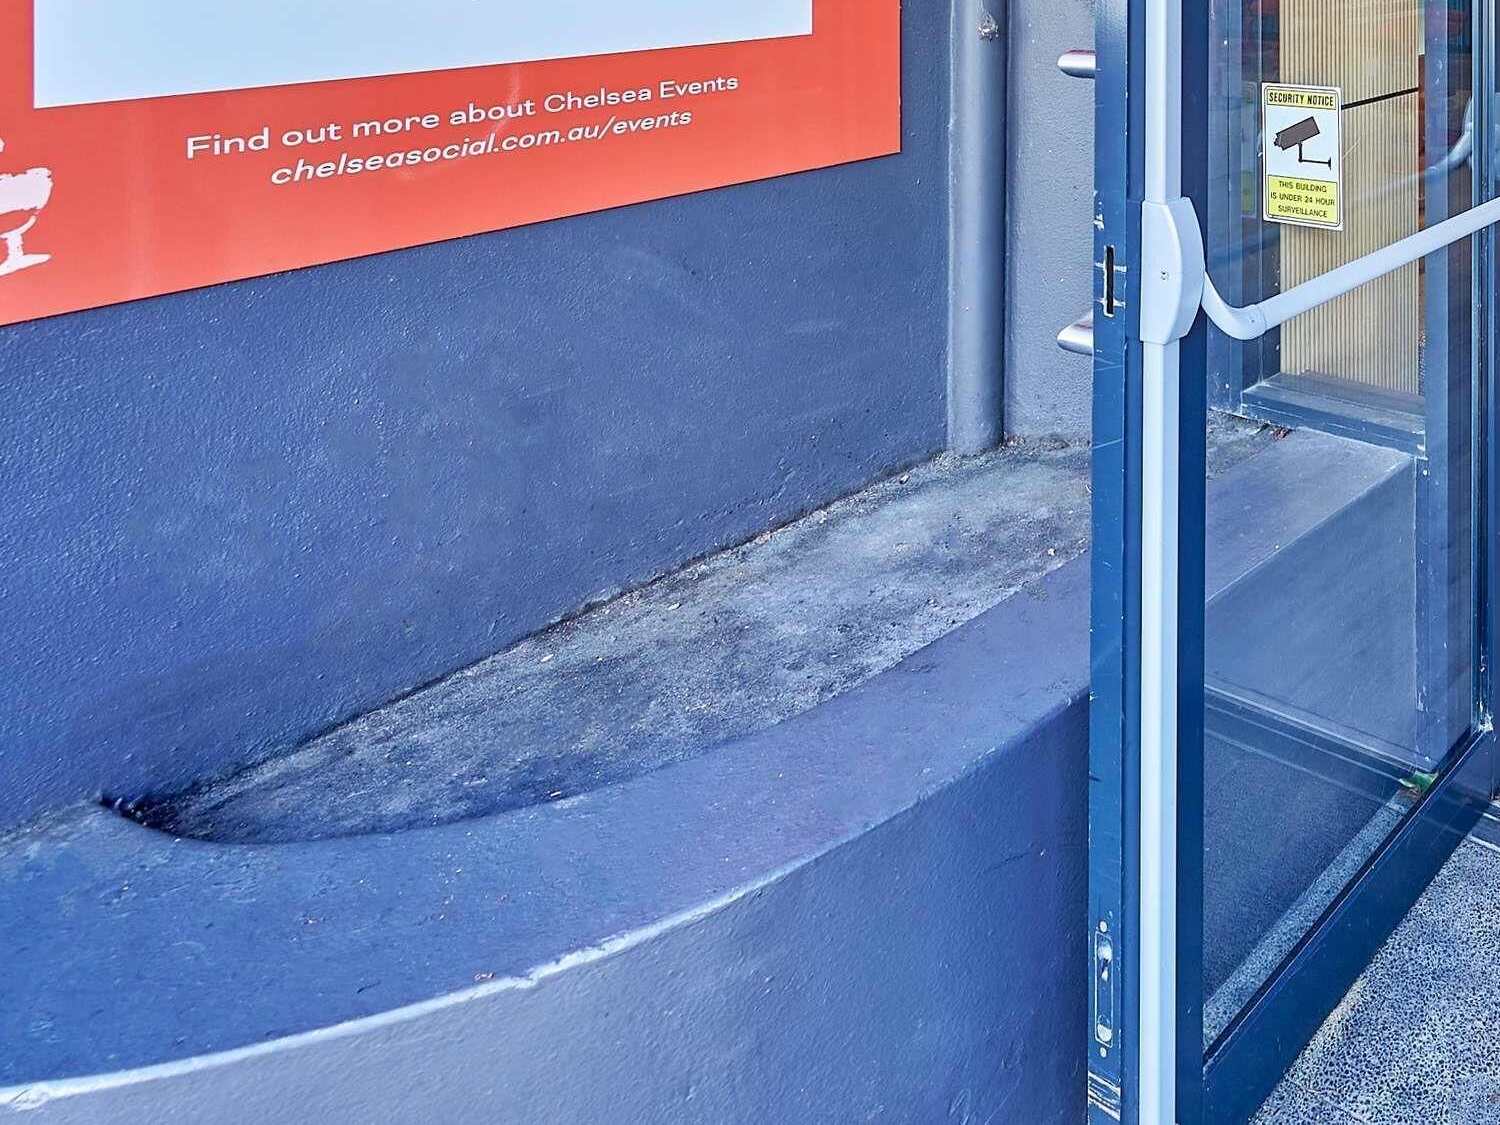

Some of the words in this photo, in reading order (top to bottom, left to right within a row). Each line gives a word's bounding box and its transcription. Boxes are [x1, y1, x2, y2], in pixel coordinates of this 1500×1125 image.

[1269, 92, 1304, 104] SECURITY
[1307, 94, 1334, 107] NOTICE
[188, 127, 268, 158] Find
[282, 124, 341, 145] out
[353, 115, 439, 137] more
[450, 100, 535, 124] about
[545, 88, 651, 112] Chelsea
[661, 77, 738, 98] Events
[272, 112, 691, 184] chelseasocial.com.au/events
[1279, 180, 1294, 189] THIS
[1296, 183, 1327, 193] BUILDING
[1270, 192, 1277, 200] IS
[1279, 193, 1302, 203] UNDER
[1316, 197, 1336, 207] HOUR
[1278, 204, 1328, 218] SURVEILLANCE
